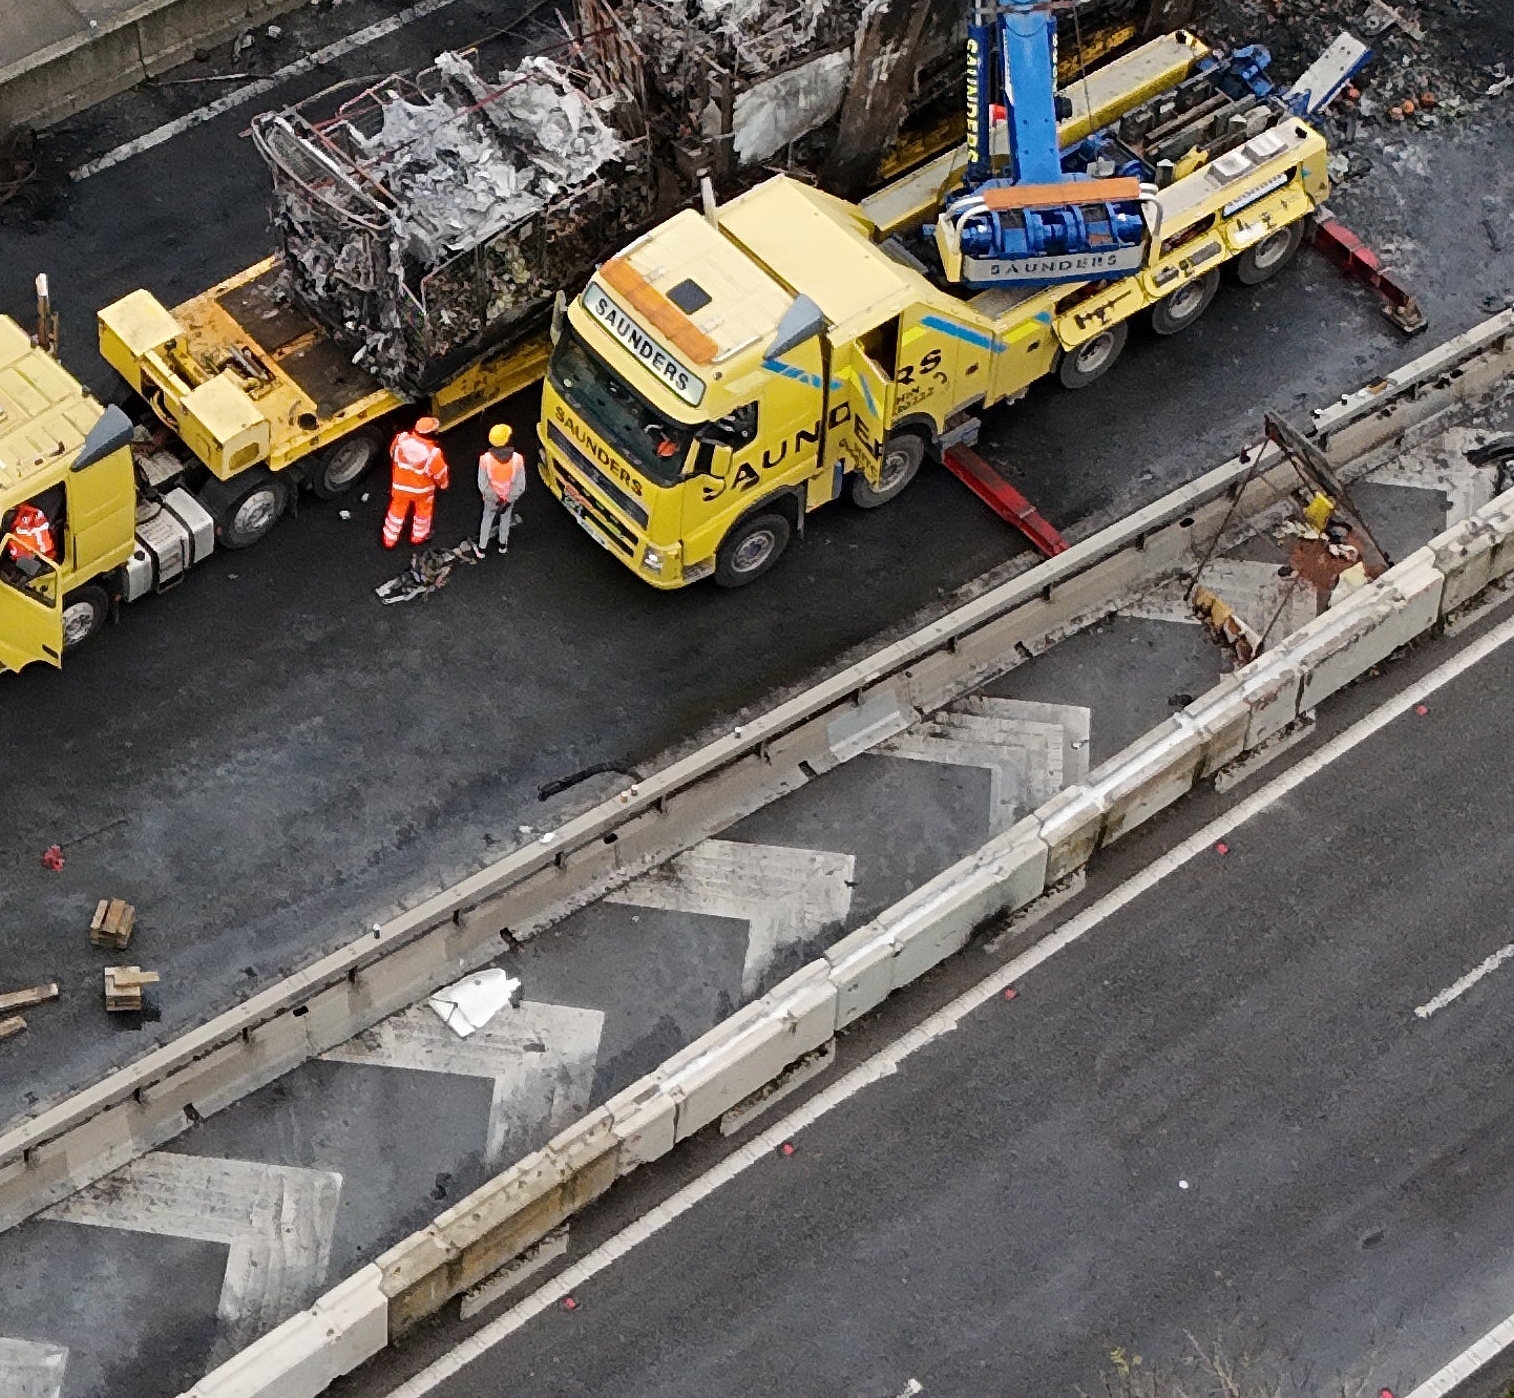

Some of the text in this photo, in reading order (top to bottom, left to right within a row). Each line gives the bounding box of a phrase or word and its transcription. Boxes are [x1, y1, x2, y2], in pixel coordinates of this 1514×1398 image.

[966, 38, 979, 163] SAUNDERS
[990, 254, 1118, 276] SAUNDERS
[594, 298, 690, 391] SAUNDERS
[554, 405, 644, 497] SAUNDERS
